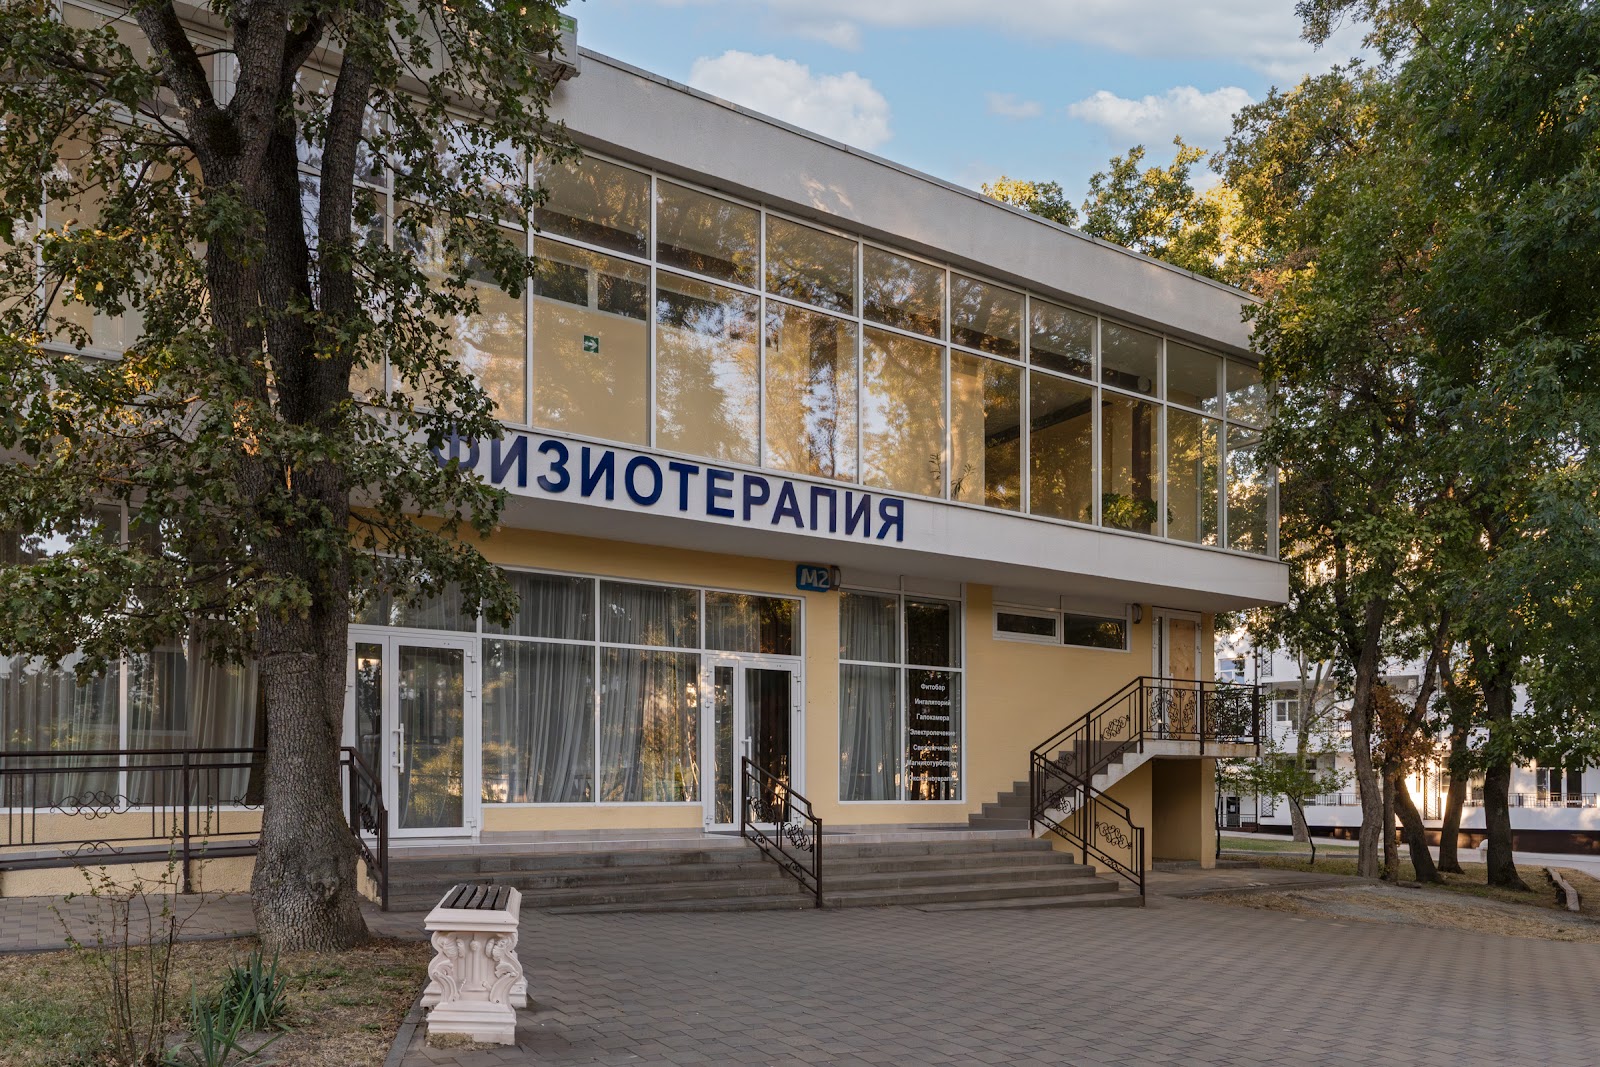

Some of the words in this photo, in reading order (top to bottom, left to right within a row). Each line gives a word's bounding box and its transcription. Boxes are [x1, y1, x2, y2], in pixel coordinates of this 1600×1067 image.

[429, 423, 904, 542] ФИЗИОТЕРАПИЯ
[920, 683, 946, 692] Фитобар
[914, 697, 952, 707] Ингаляторий
[916, 712, 950, 722] Галокамера
[909, 728, 956, 737] Электролечение
